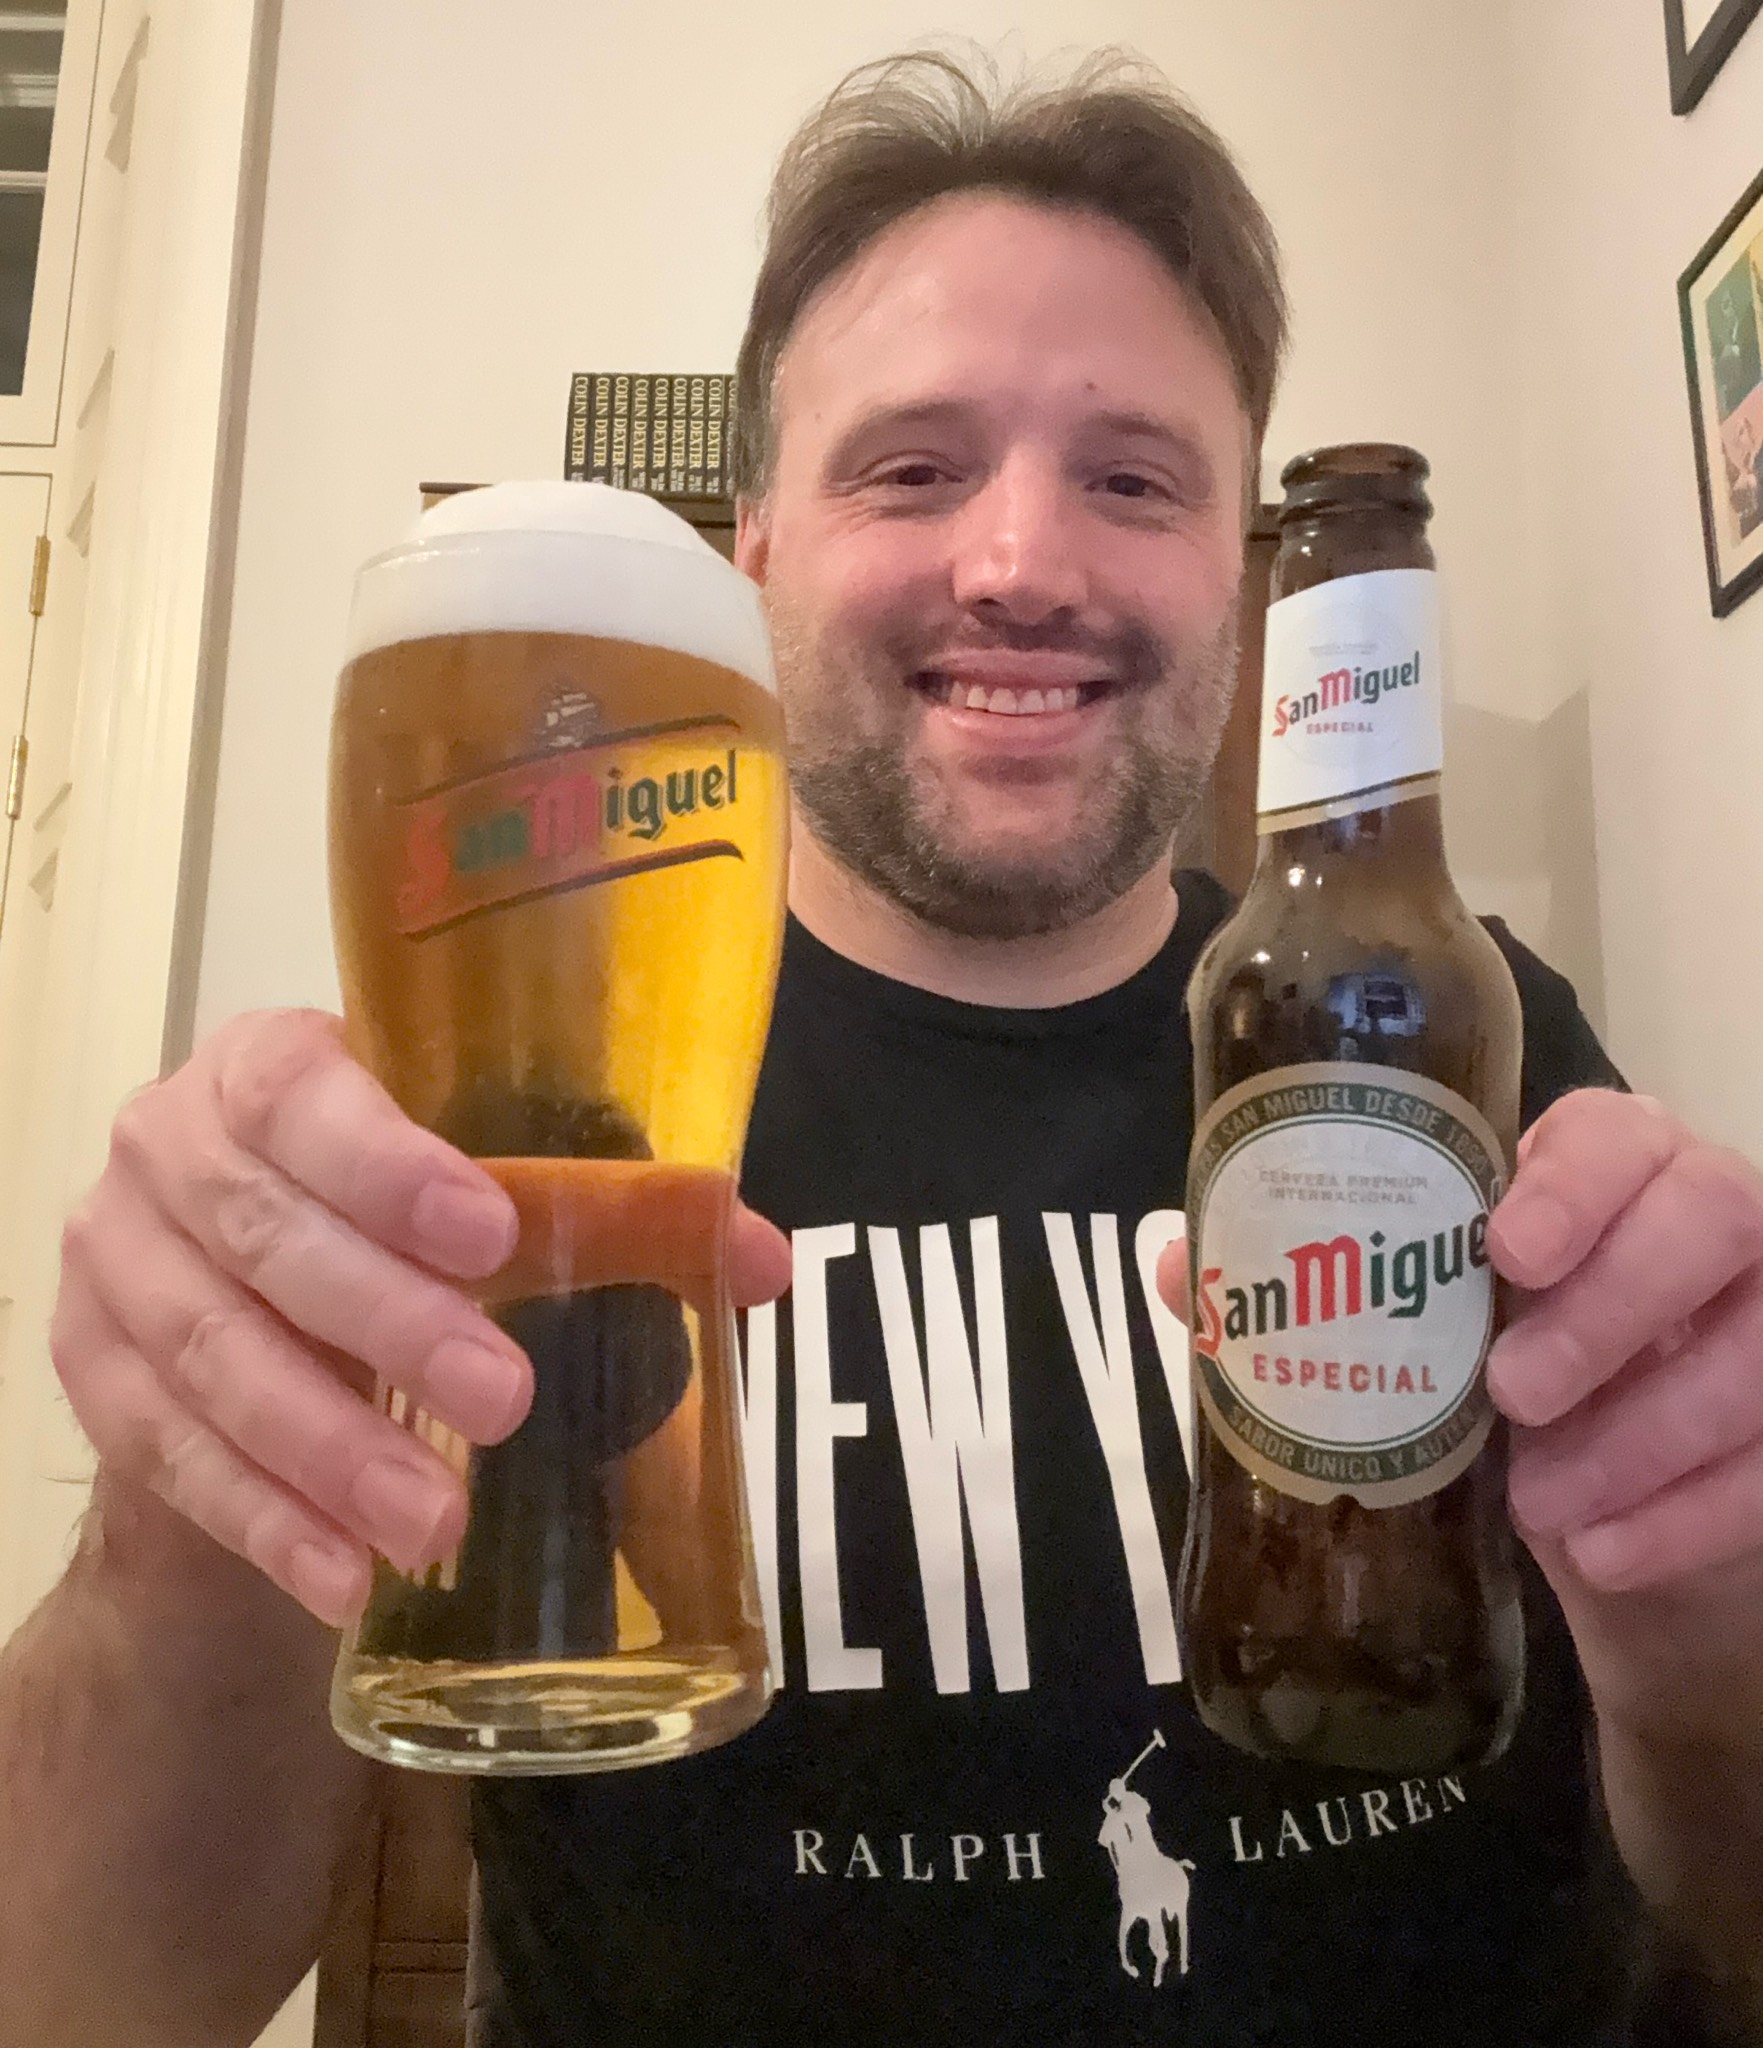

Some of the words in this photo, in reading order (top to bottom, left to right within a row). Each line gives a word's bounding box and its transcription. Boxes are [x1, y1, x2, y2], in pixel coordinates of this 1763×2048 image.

[574, 376, 588, 415] COLIN
[596, 377, 610, 416] COLIN
[615, 376, 629, 415] COLIN
[635, 379, 649, 417] COLIN
[655, 378, 669, 417] COLIN
[673, 378, 687, 416] COLIN
[691, 378, 705, 417] COLIN
[709, 378, 723, 417] COLIN
[572, 418, 587, 466] DEXTER
[593, 419, 608, 467] DEXTER
[613, 418, 627, 466] DEXTER
[632, 421, 647, 469] DEXTER
[652, 420, 667, 469] DEXTER
[671, 419, 686, 468] DEXTER
[689, 420, 703, 469] DEXTER
[707, 420, 721, 470] DEXTER
[1306, 721, 1374, 735] ESPECIAL
[1220, 1104, 1260, 1141] SAN
[1263, 1086, 1356, 1119] MIGUEL
[1365, 1090, 1443, 1134] DESDE
[1253, 1352, 1438, 1395] ESPECIAL
[1229, 1405, 1295, 1467] SABOR
[1391, 1453, 1406, 1476] Y
[793, 1828, 1046, 1882] RALPH
[1228, 1775, 1468, 1862] LAUREN
